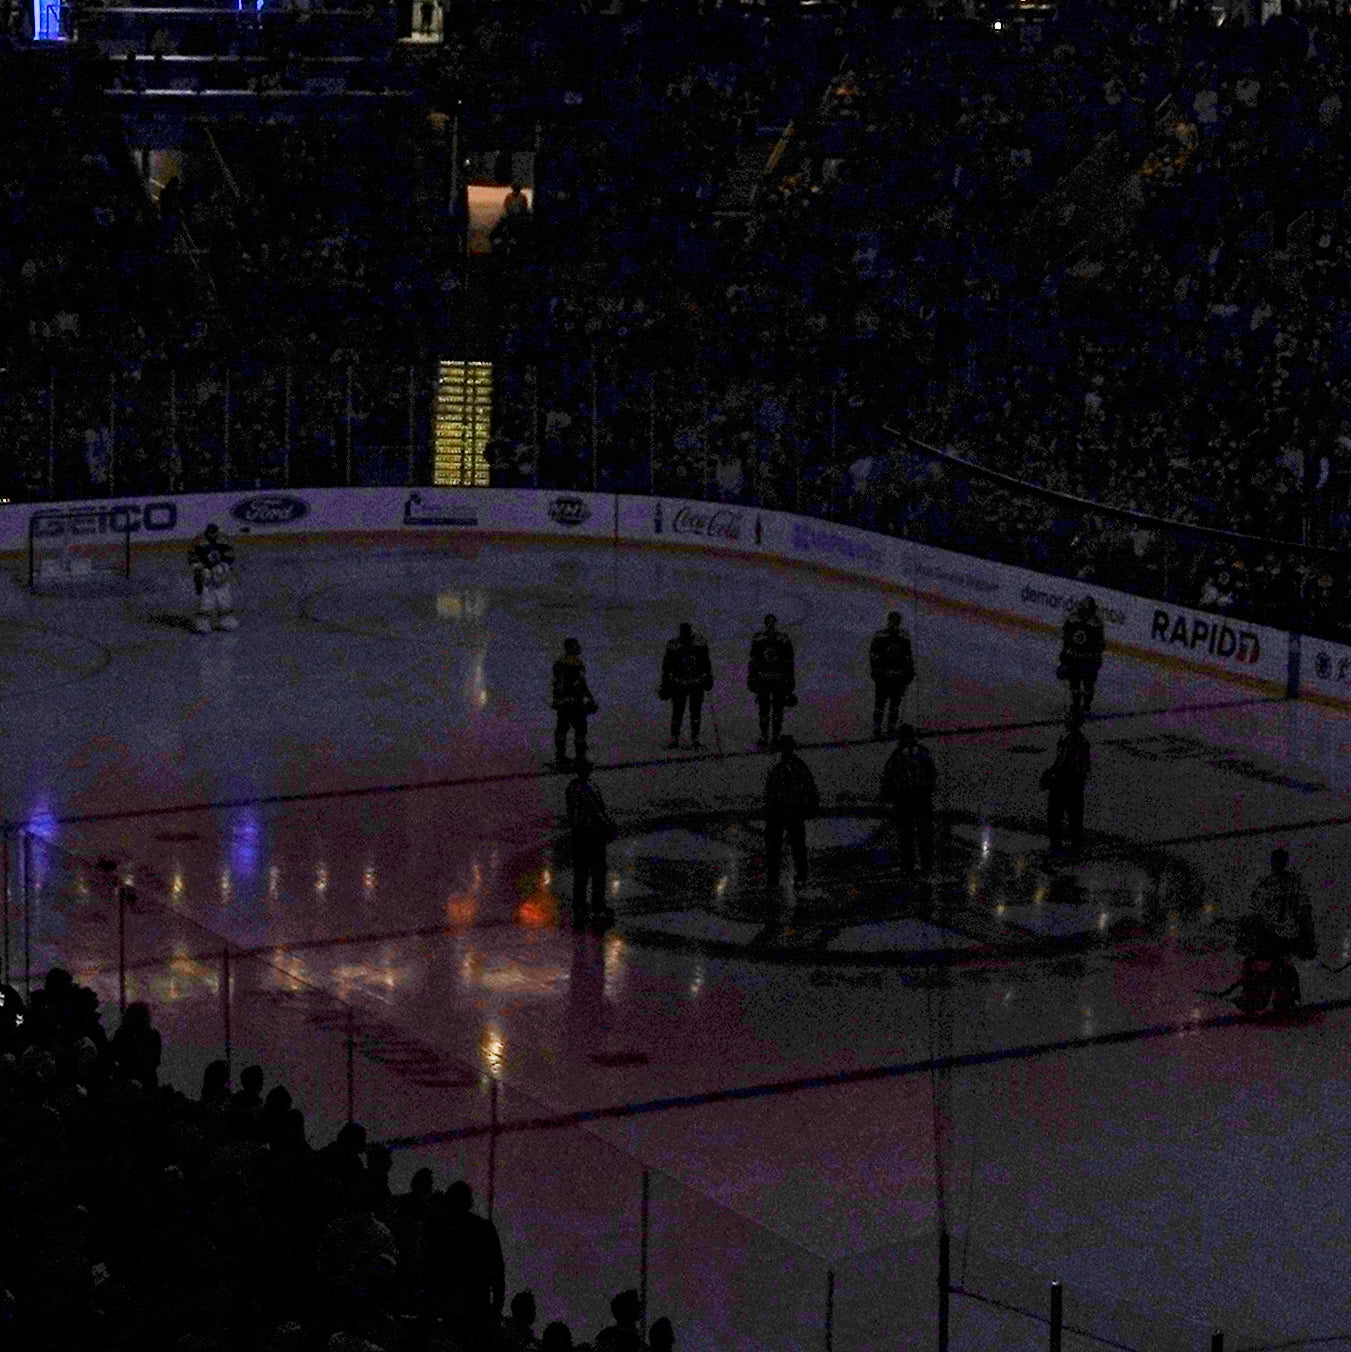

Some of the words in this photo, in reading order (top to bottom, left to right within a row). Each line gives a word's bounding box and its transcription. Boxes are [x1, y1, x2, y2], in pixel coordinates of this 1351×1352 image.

[33, 502, 178, 537] GEICO
[245, 497, 295, 523] Ford
[672, 505, 742, 540] Coca-Cola
[1151, 609, 1261, 665] RAPID7
